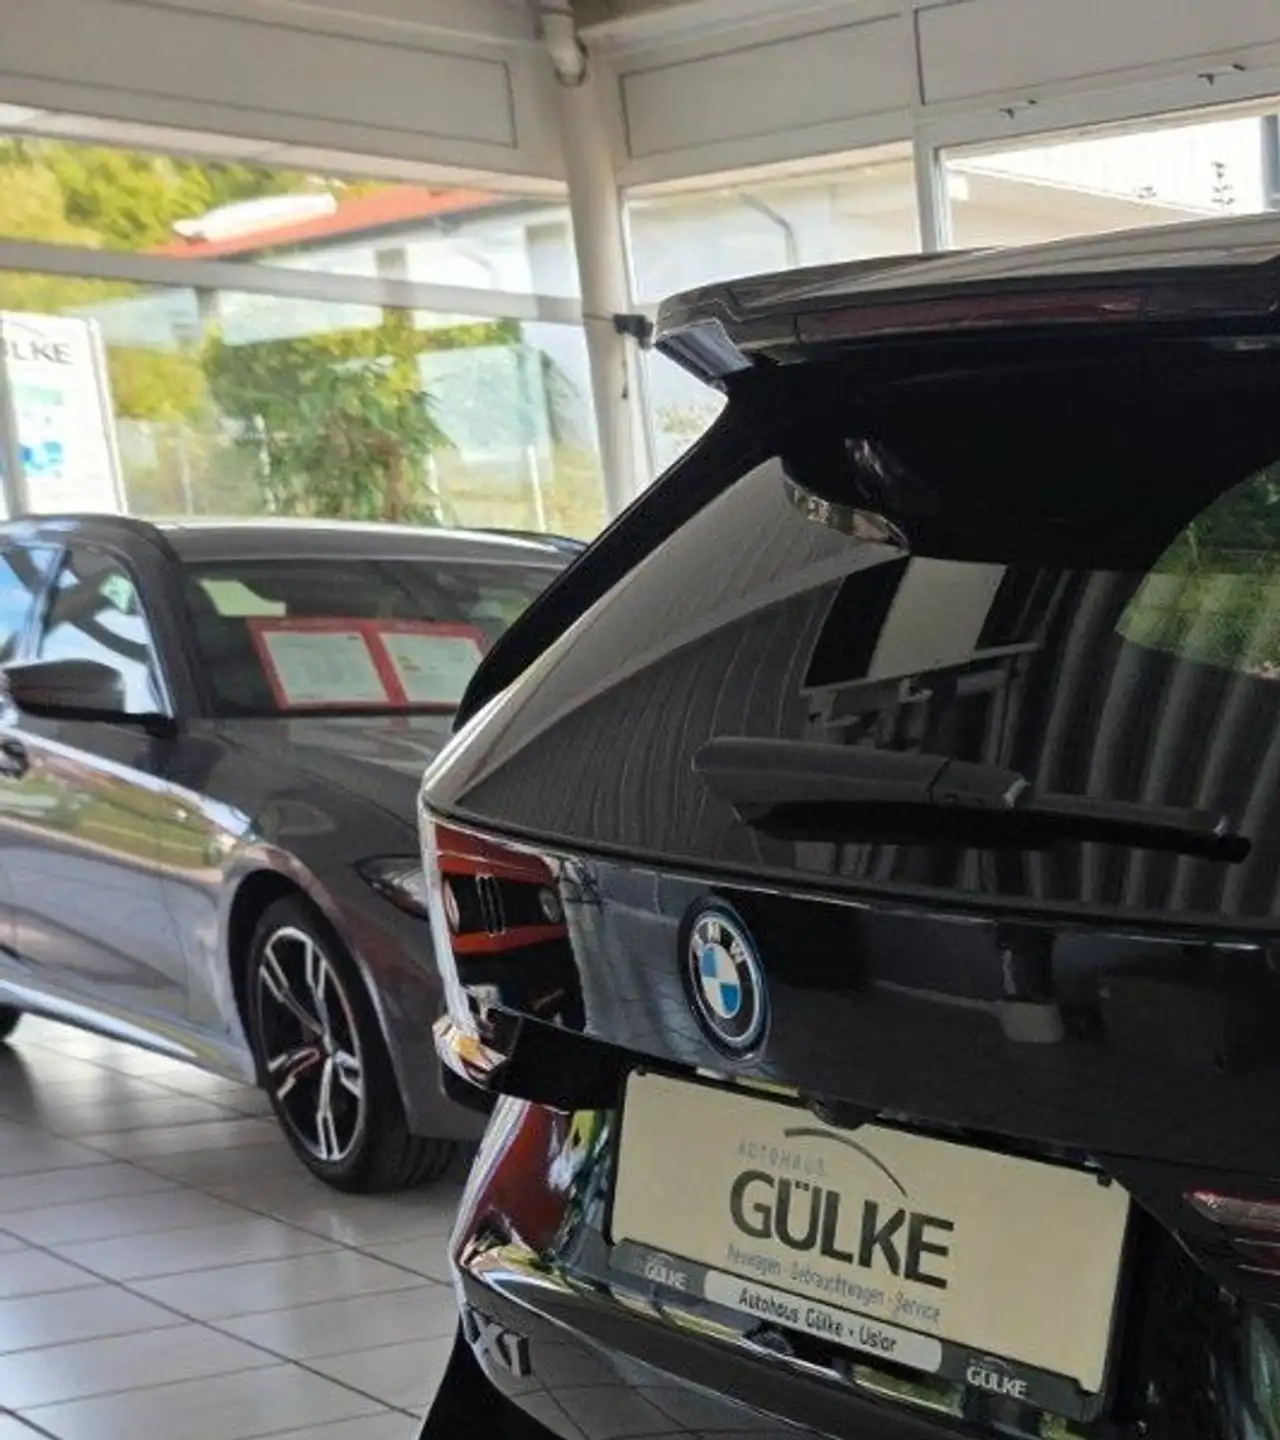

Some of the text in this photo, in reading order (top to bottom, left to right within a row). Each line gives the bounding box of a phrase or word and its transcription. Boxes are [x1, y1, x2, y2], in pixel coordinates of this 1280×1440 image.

[729, 1169, 955, 1290] GÜLKE
[738, 1287, 800, 1323] Autohaus
[804, 1308, 843, 1338] Gülke
